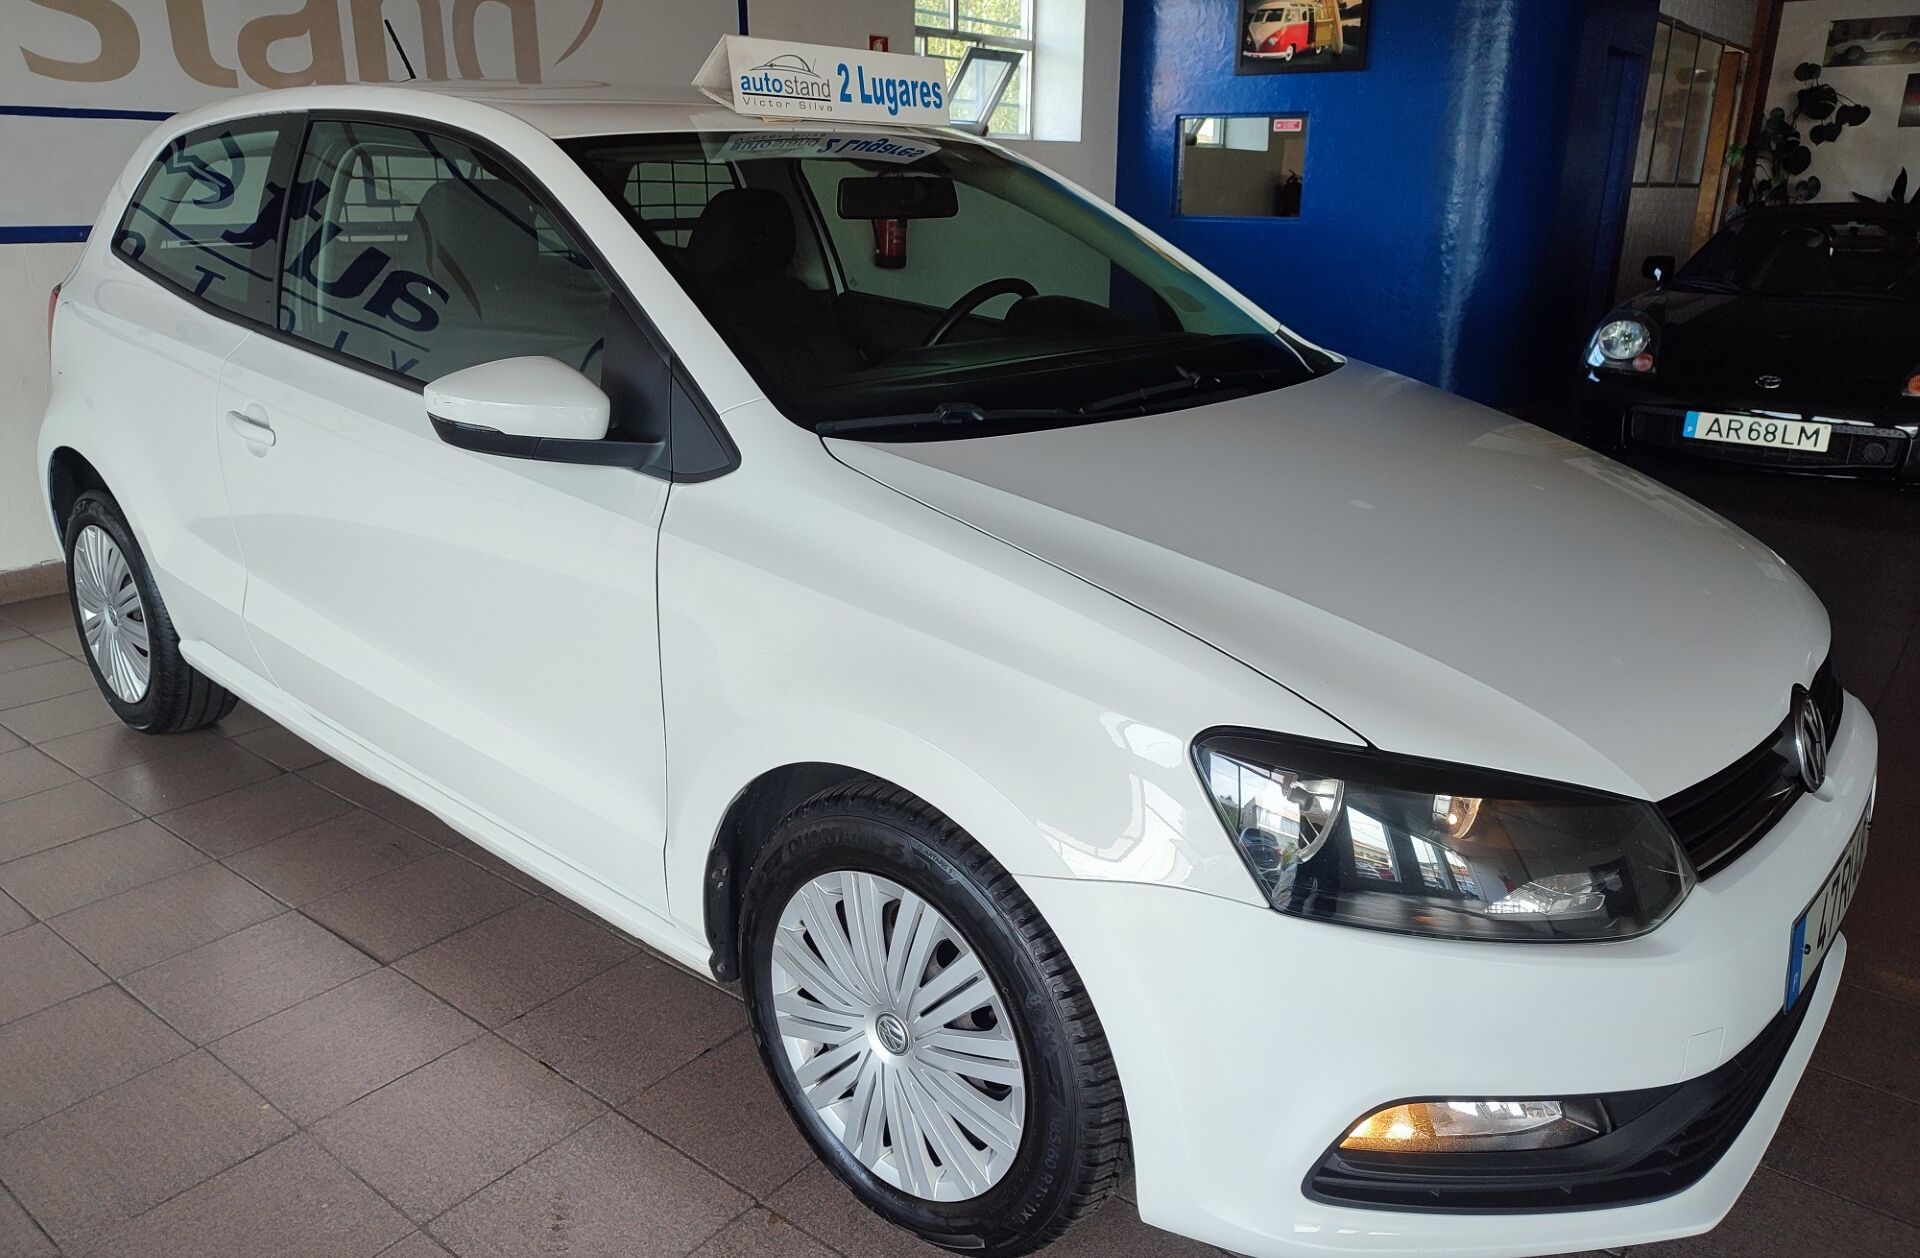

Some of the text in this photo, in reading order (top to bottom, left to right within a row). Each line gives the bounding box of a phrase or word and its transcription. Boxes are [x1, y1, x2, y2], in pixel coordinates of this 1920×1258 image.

[740, 72, 831, 99] autostand
[837, 63, 943, 116] 2 Lugares
[742, 96, 833, 112] Victor Silva
[1705, 417, 1822, 448] AR68LM
